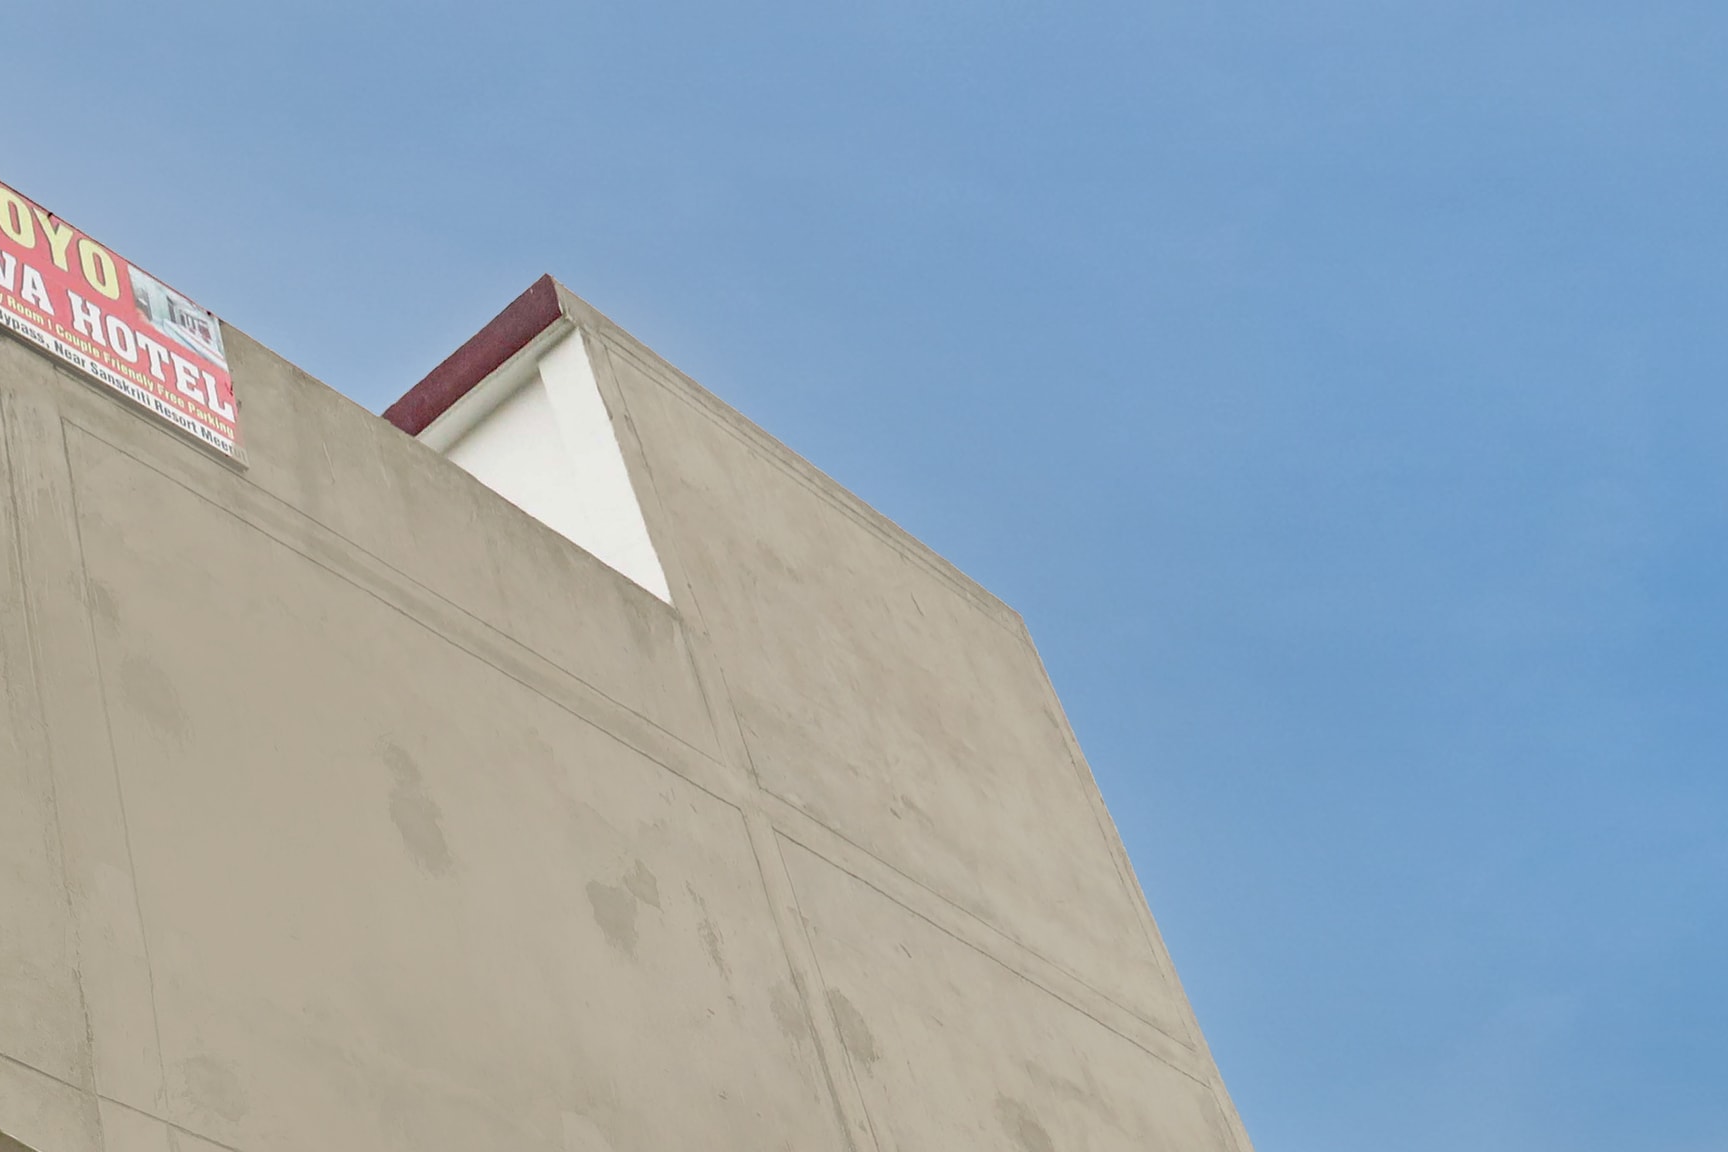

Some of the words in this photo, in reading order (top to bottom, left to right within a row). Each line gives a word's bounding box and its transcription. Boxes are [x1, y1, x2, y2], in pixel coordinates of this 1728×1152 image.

[7, 295, 46, 326] Room
[56, 323, 101, 358] Couple
[103, 352, 155, 392] Friendly
[188, 402, 235, 440] Parking
[55, 340, 86, 368] Near
[90, 361, 152, 407] Sanskriti
[154, 400, 199, 434] Resort
[67, 290, 235, 424] HOTEL
